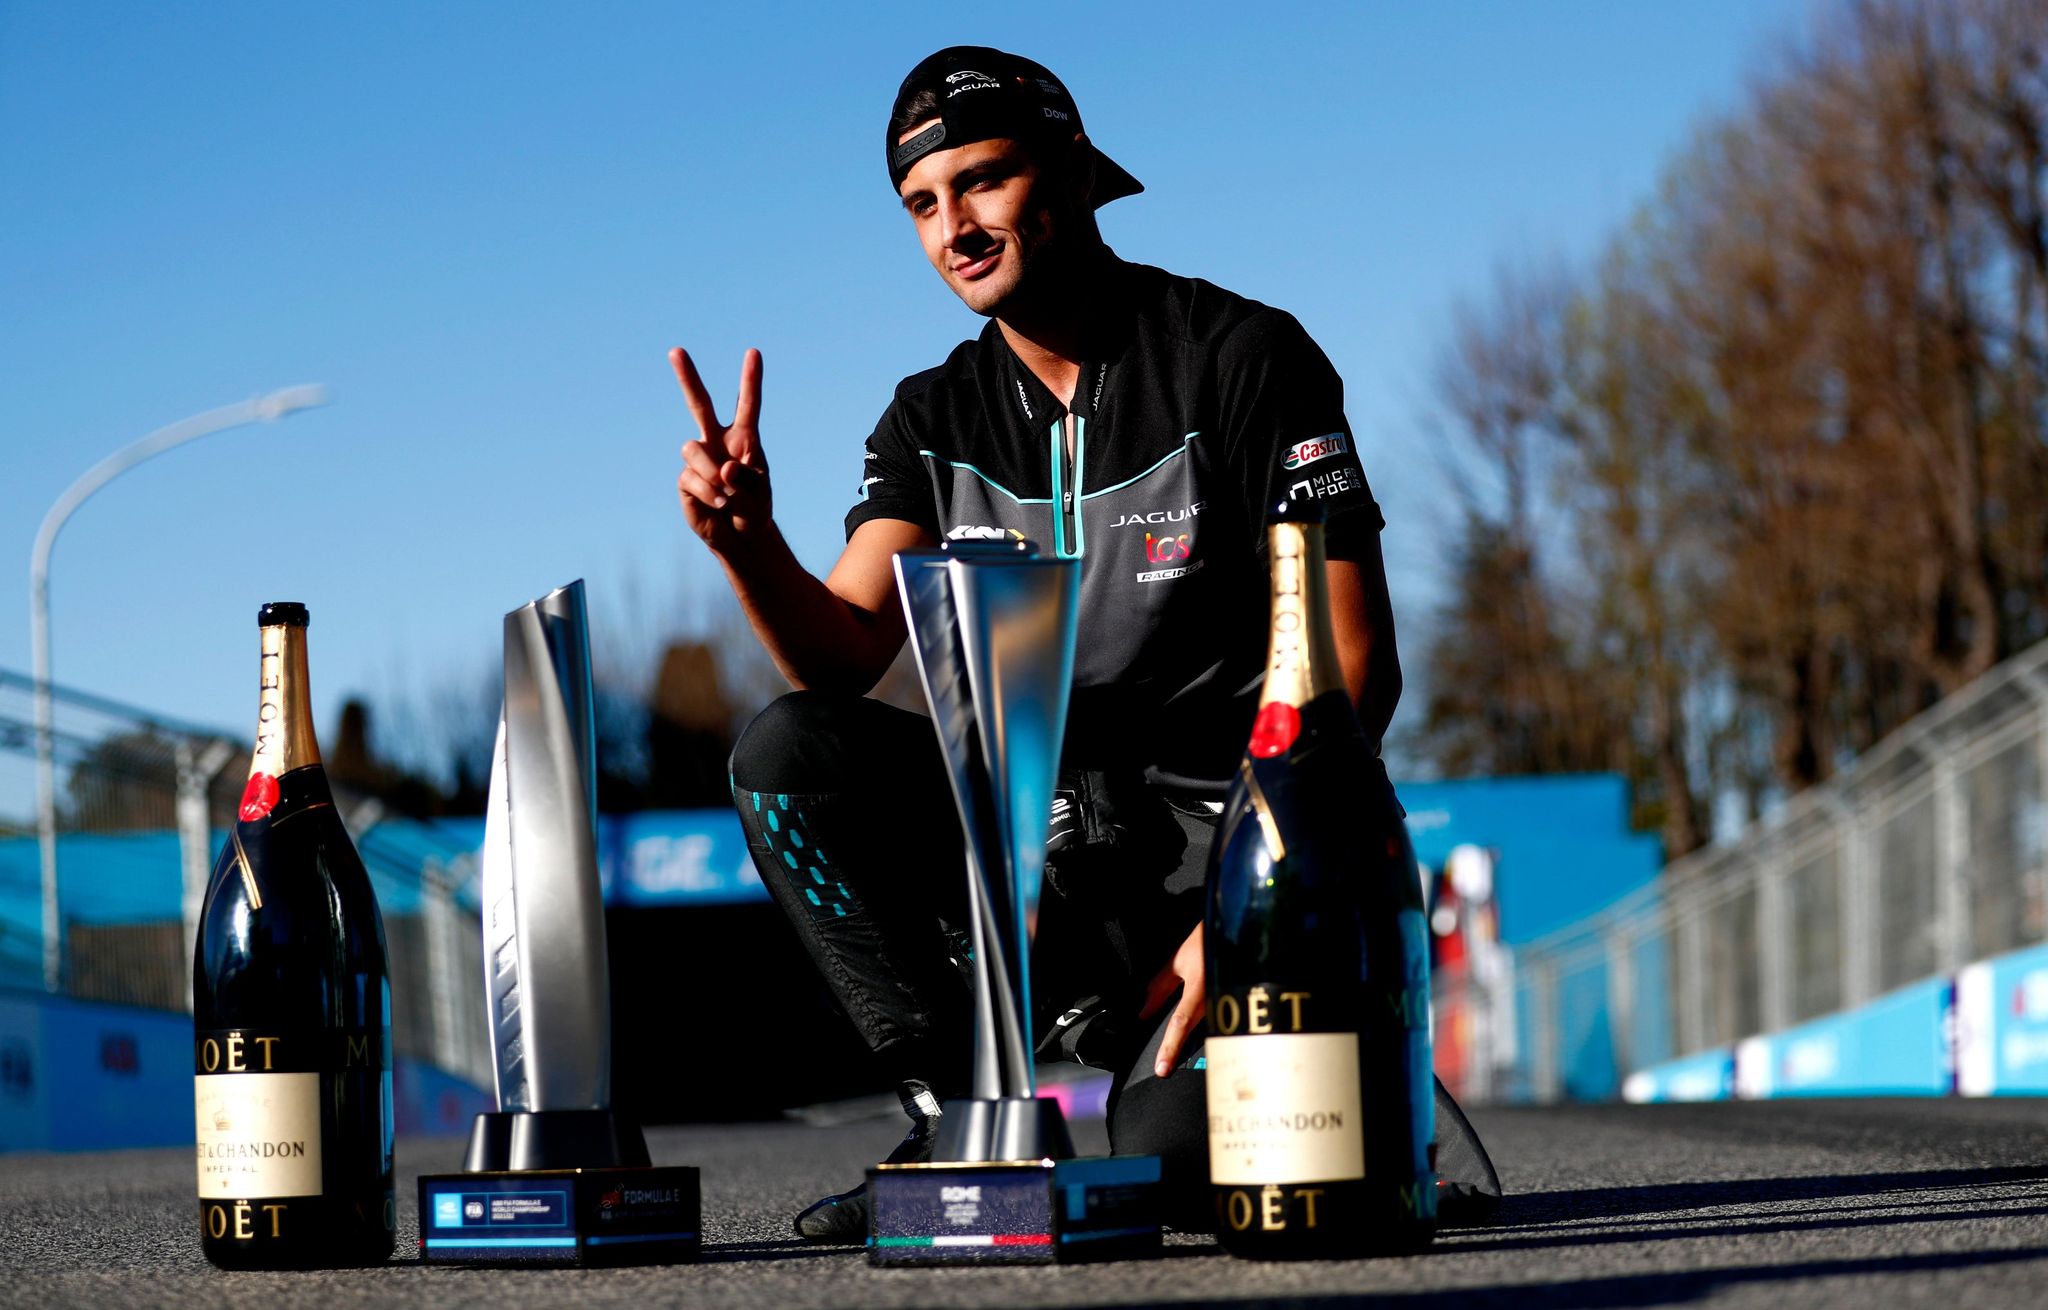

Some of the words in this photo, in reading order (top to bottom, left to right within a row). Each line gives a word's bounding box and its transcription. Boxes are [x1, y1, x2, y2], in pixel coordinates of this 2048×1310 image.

[946, 82, 1001, 98] JAGUAR
[1016, 380, 1033, 420] JAGUAR
[1092, 363, 1107, 411] JAGUAR
[1109, 501, 1208, 528] JAGUAR
[1206, 986, 1311, 1035] OËT
[196, 1031, 281, 1073] OËT
[201, 1200, 288, 1240] OËT
[1216, 1184, 1325, 1231] OËT
